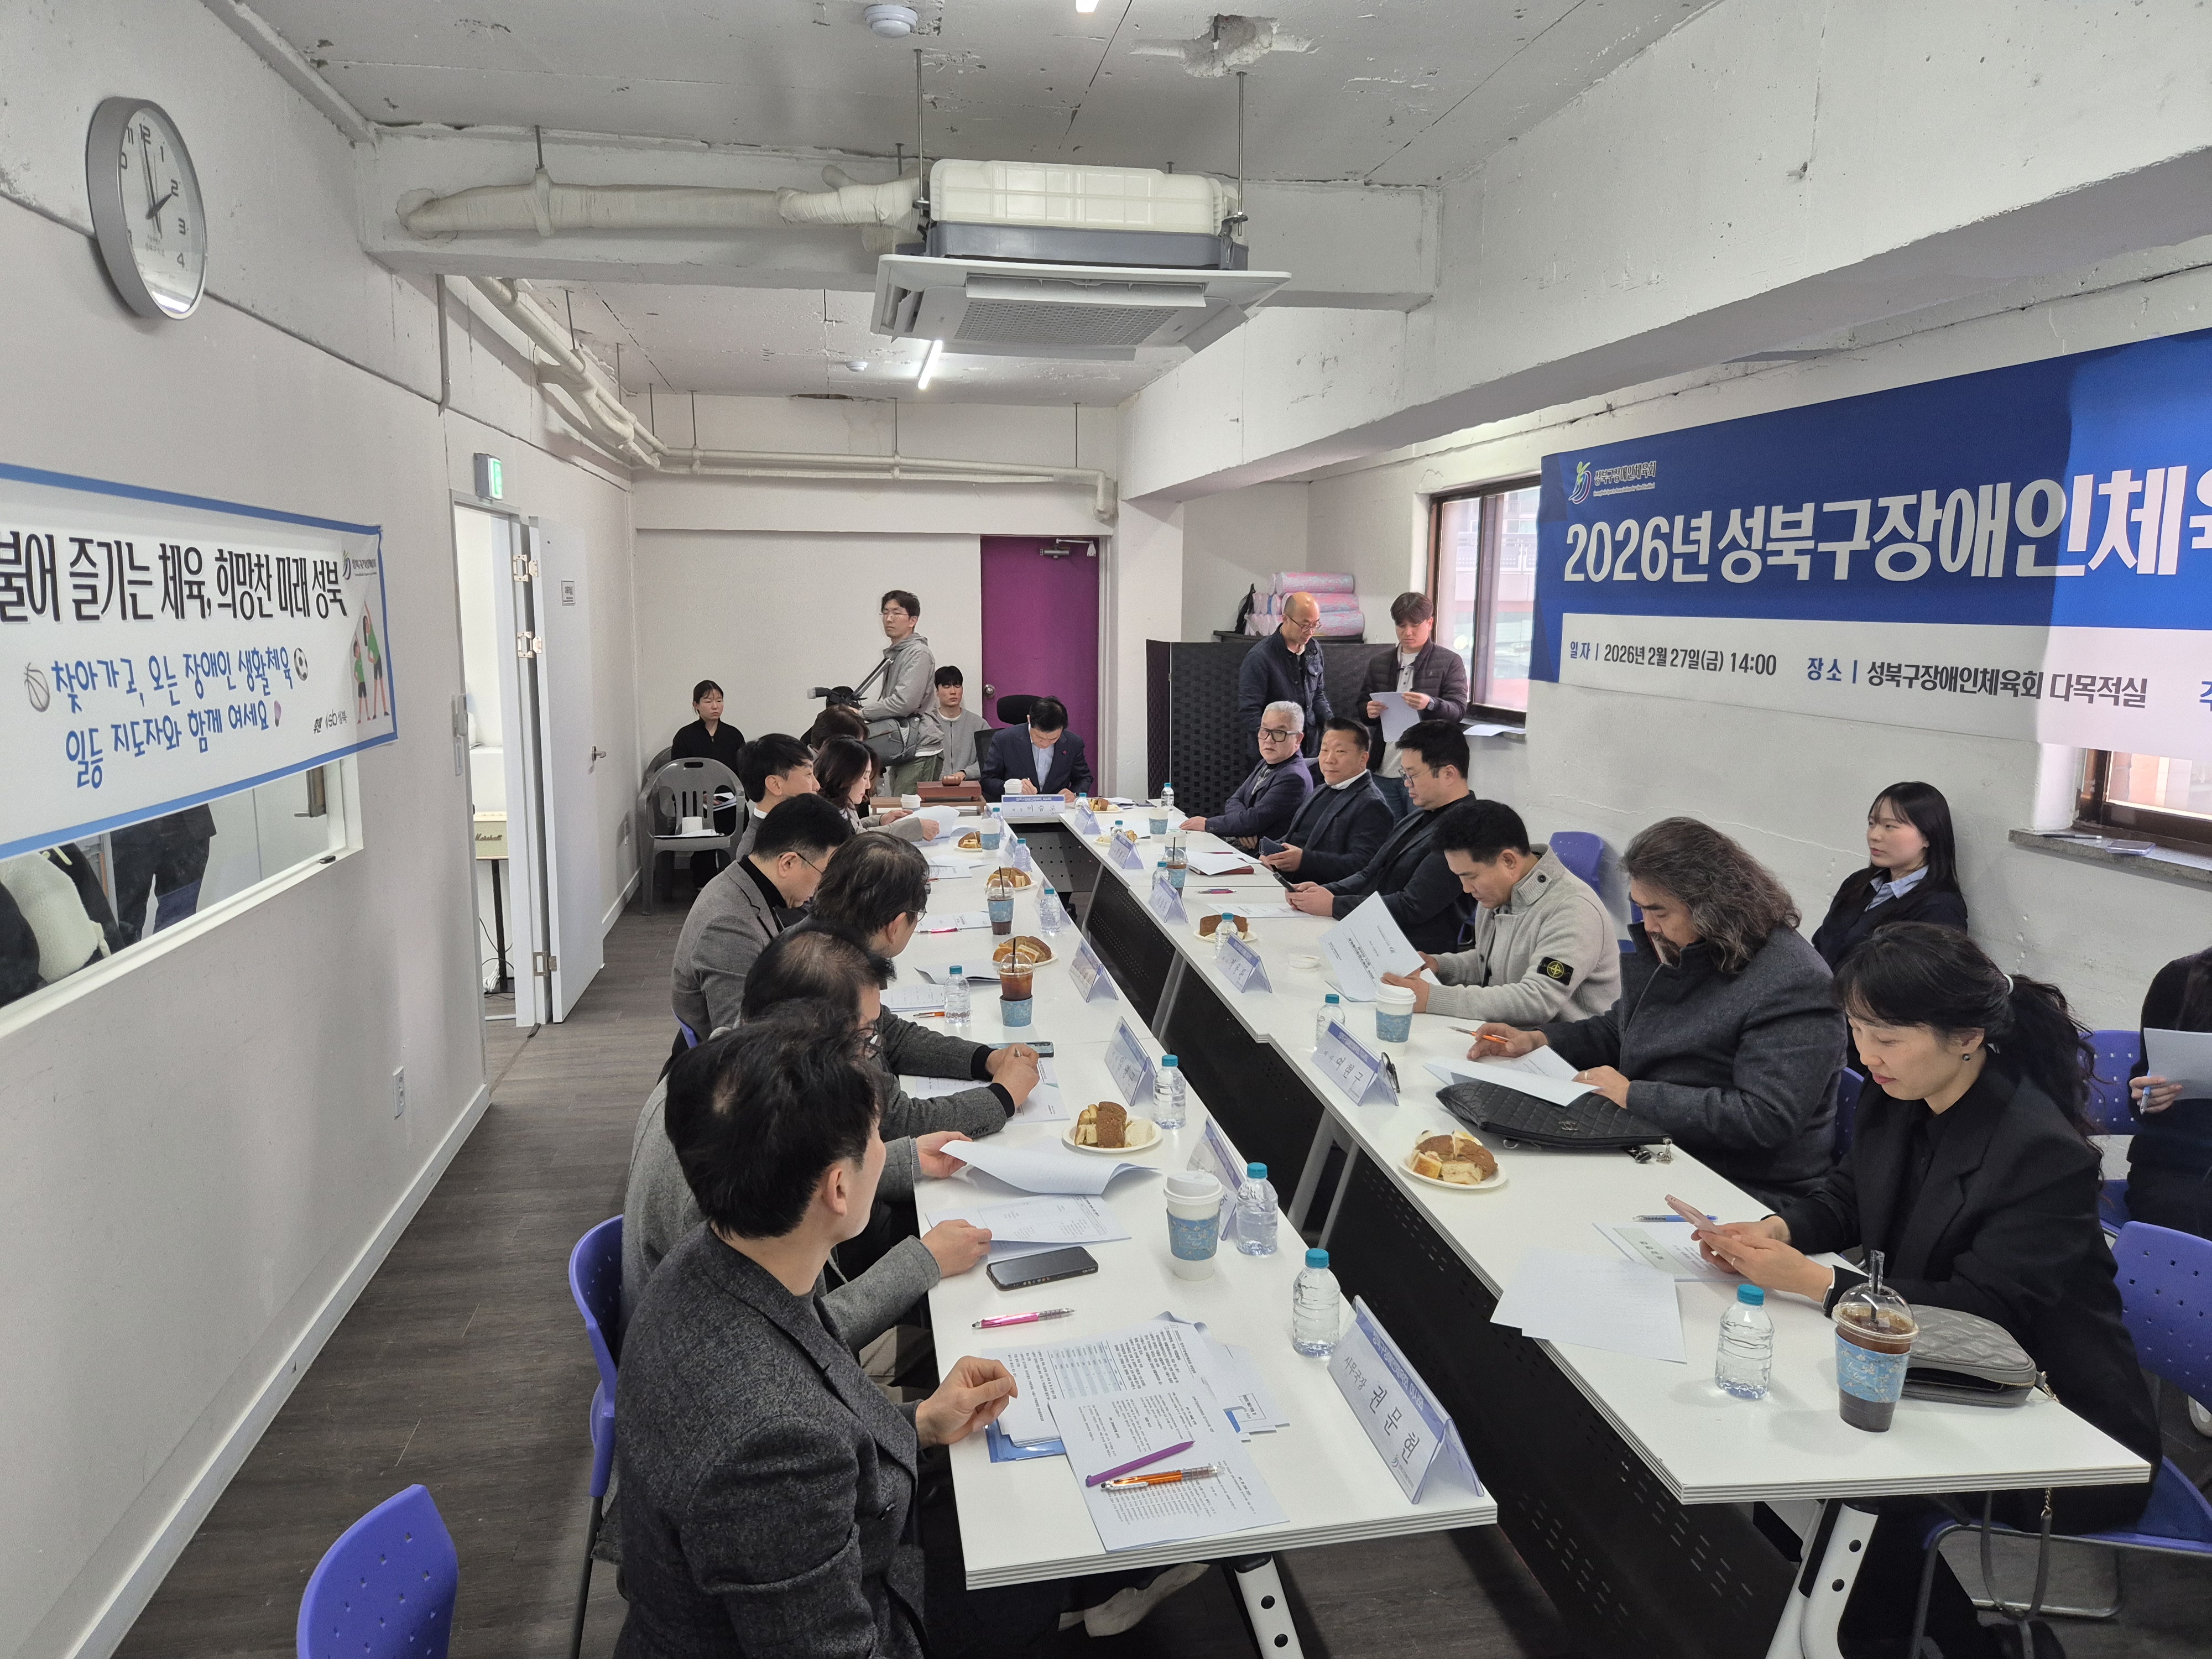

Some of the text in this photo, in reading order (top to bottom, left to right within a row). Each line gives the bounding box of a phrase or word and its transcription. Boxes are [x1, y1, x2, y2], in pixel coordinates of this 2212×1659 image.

[139, 123, 152, 144] 12
[170, 179, 179, 197] 2
[178, 218, 185, 234] 3
[177, 253, 185, 268] 4
[1594, 461, 1656, 486] 성북구장애인체육회
[1564, 510, 1712, 582] 2026년
[69, 537, 153, 620] 즐기는
[158, 543, 211, 619] 체육,
[215, 549, 273, 620] 희망찬
[276, 556, 311, 618] 미래
[312, 560, 348, 619] 성북
[1569, 640, 1777, 676] 일자 2026년 2월 27일(금) 14:00
[148, 655, 181, 706] 오는
[182, 650, 237, 700] 장애인
[238, 646, 293, 696] 생활체육
[1807, 657, 2148, 709] 장소 성북구장애인체육회 다목적실
[66, 700, 269, 789] 일등 지도자와 함께 여세요
[1352, 1071, 1364, 1086] 구
[1344, 1356, 1420, 1465] 사무국장 권 문 현
[1410, 1383, 1424, 1411] 이사회
